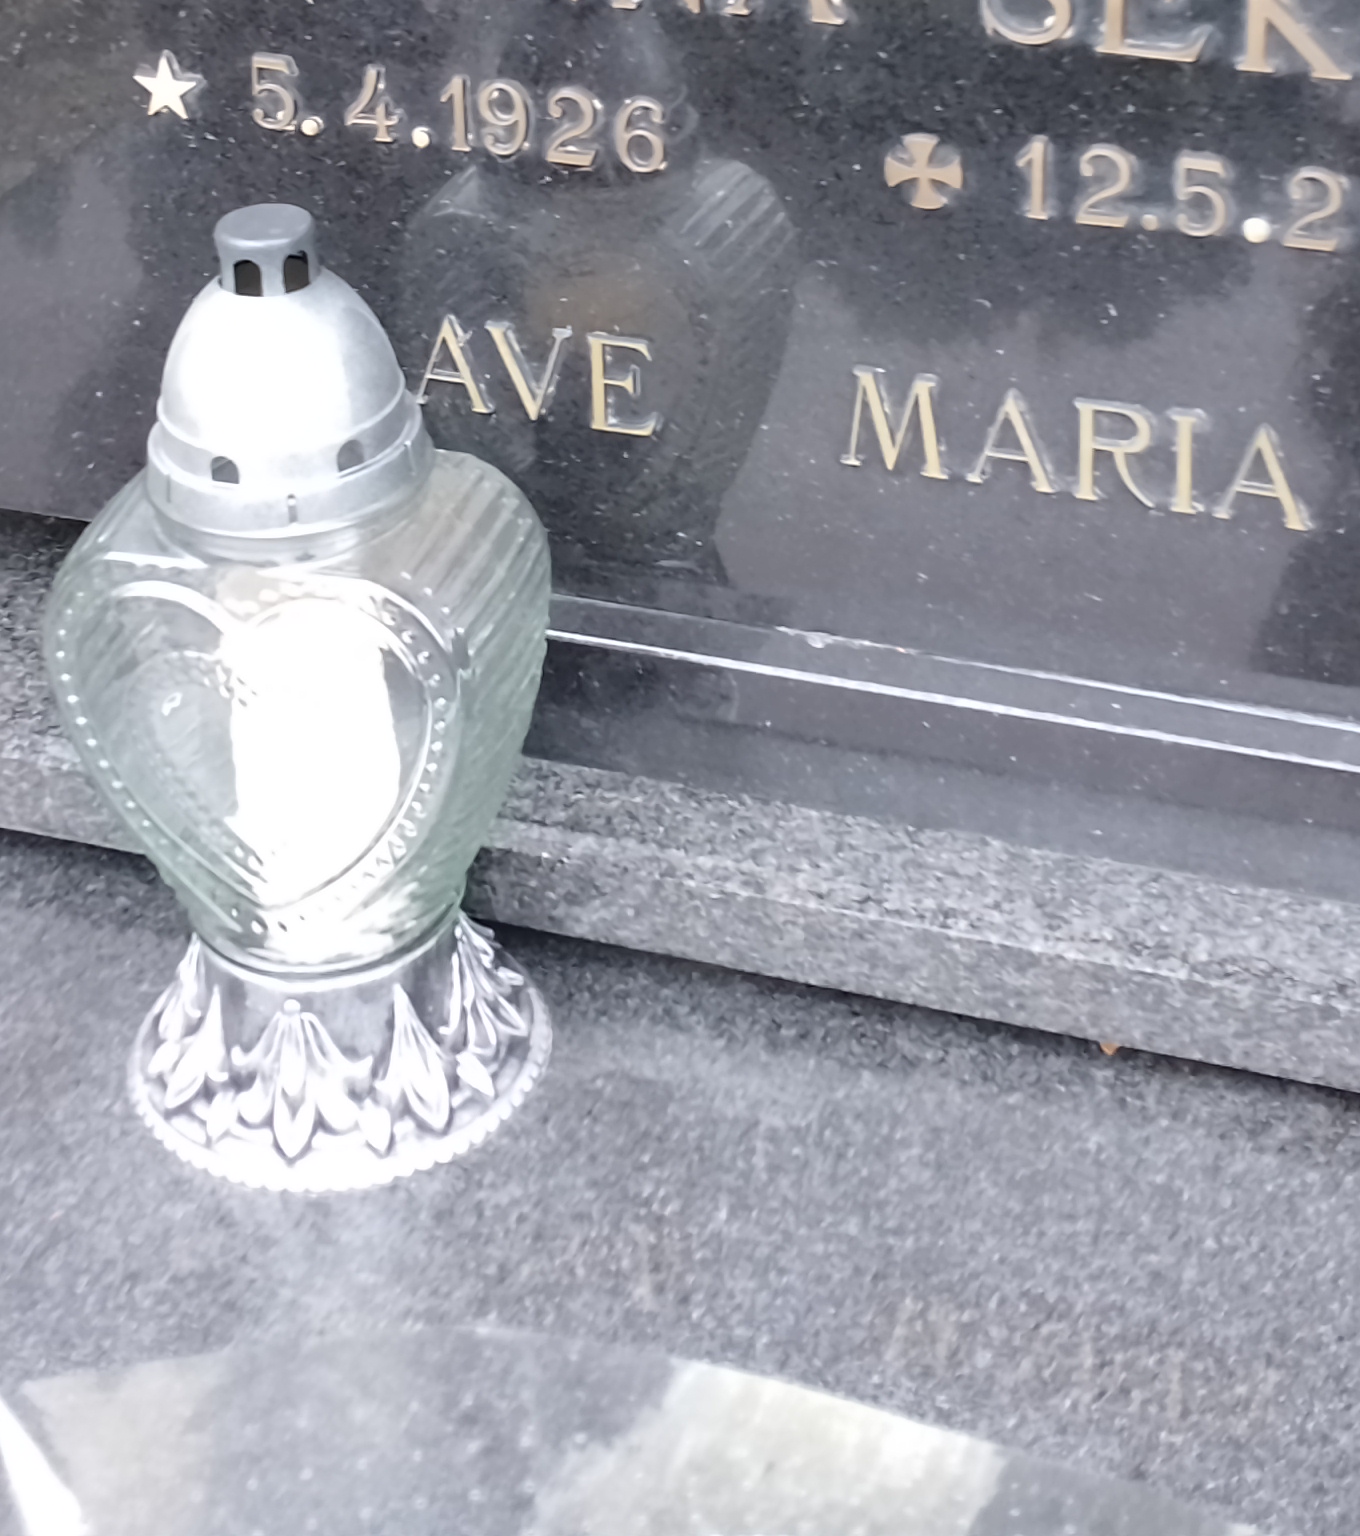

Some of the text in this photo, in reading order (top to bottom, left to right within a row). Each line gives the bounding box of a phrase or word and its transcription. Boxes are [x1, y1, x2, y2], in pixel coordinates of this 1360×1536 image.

[248, 52, 670, 173] 5.4.1926
[418, 312, 1316, 532] AVE MARIA
